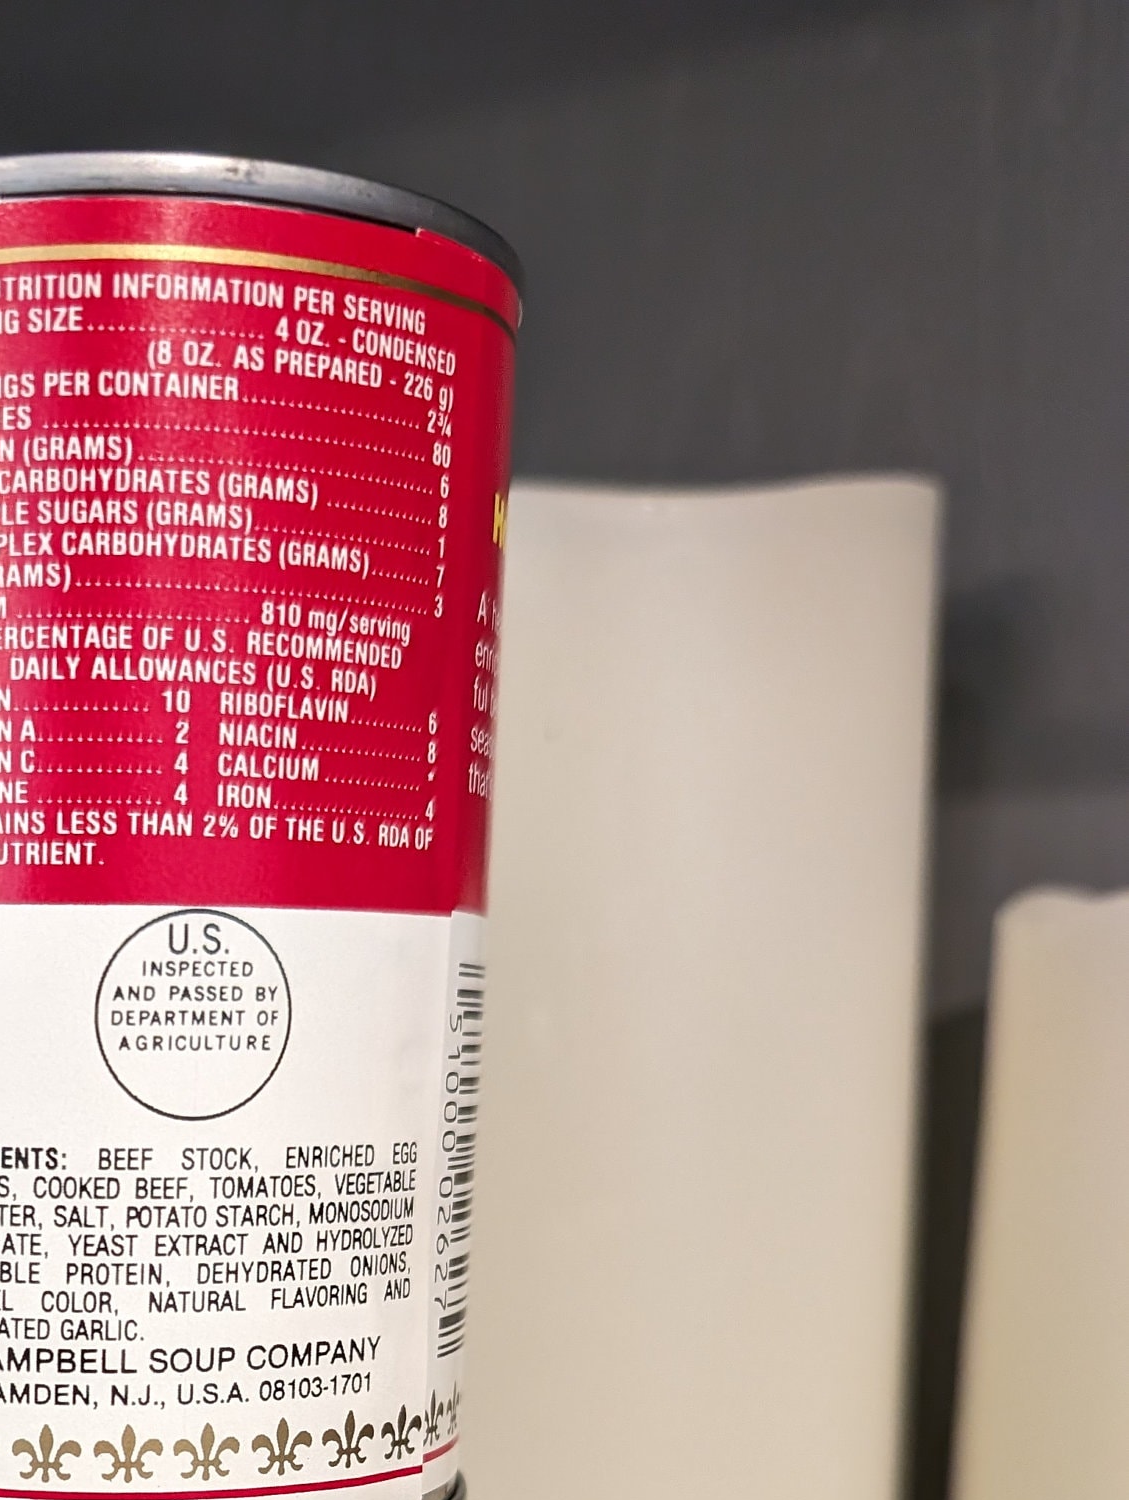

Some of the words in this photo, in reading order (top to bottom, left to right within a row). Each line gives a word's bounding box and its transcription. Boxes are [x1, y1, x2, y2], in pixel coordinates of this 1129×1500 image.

[113, 273, 284, 308] INFORMATION
[294, 286, 334, 315] PER
[344, 294, 426, 335] SERVING
[28, 308, 83, 333] SIZE
[274, 319, 288, 343] 4
[295, 322, 330, 348] OZ.
[352, 329, 456, 376] CONDENSED
[43, 372, 88, 398] PER
[98, 371, 238, 401] CONTAINER
[147, 340, 172, 369] (8
[183, 342, 222, 368] OZ.
[234, 346, 264, 372] AS
[274, 350, 382, 389] PREPARED
[404, 372, 433, 399] 226
[439, 384, 454, 412] g)
[23, 435, 133, 465] (GRAMS)
[439, 475, 449, 499] 6
[432, 441, 451, 468] 80
[218, 471, 318, 510] (GRAMS)
[438, 504, 448, 530] 8
[261, 602, 302, 628] 810
[308, 606, 411, 648] mg/serving
[142, 625, 173, 650] OF
[184, 629, 234, 654] U.S.
[247, 630, 402, 670] RECOMMENDED
[10, 656, 79, 682] DAILY
[92, 656, 257, 687] ALLOWANCES
[266, 666, 322, 693] (U.S.
[330, 670, 377, 701] RDA)
[161, 689, 190, 714] 10
[219, 691, 348, 725] RIBOFLAVIN
[428, 711, 437, 738] 6
[218, 722, 297, 750] NIACIN
[427, 738, 436, 765] 8
[169, 923, 230, 955] U.S.
[143, 960, 253, 977] INSPECTED
[112, 986, 155, 1001] AND
[169, 986, 243, 1001] PASSED
[256, 986, 278, 1001] BY
[112, 1010, 245, 1026] DEPARTMENT
[257, 1010, 278, 1026] OF
[119, 1035, 271, 1051] AGRICULTURE
[98, 1147, 153, 1171] BEEF
[181, 1147, 259, 1173] STOCK,
[285, 1144, 374, 1168] ENRICHED
[392, 1142, 418, 1165] EGG
[33, 1176, 120, 1200] COOKED
[134, 1177, 193, 1202] BEEF,
[209, 1175, 321, 1201] TOMATOES,
[334, 1169, 417, 1195] VEGETABLE
[148, 1347, 236, 1374] SOUP
[247, 1336, 382, 1371] COMPANY
[110, 1384, 166, 1410] N.J.,
[177, 1381, 250, 1405] U.S.A.
[259, 1371, 372, 1403] 08103-1701
